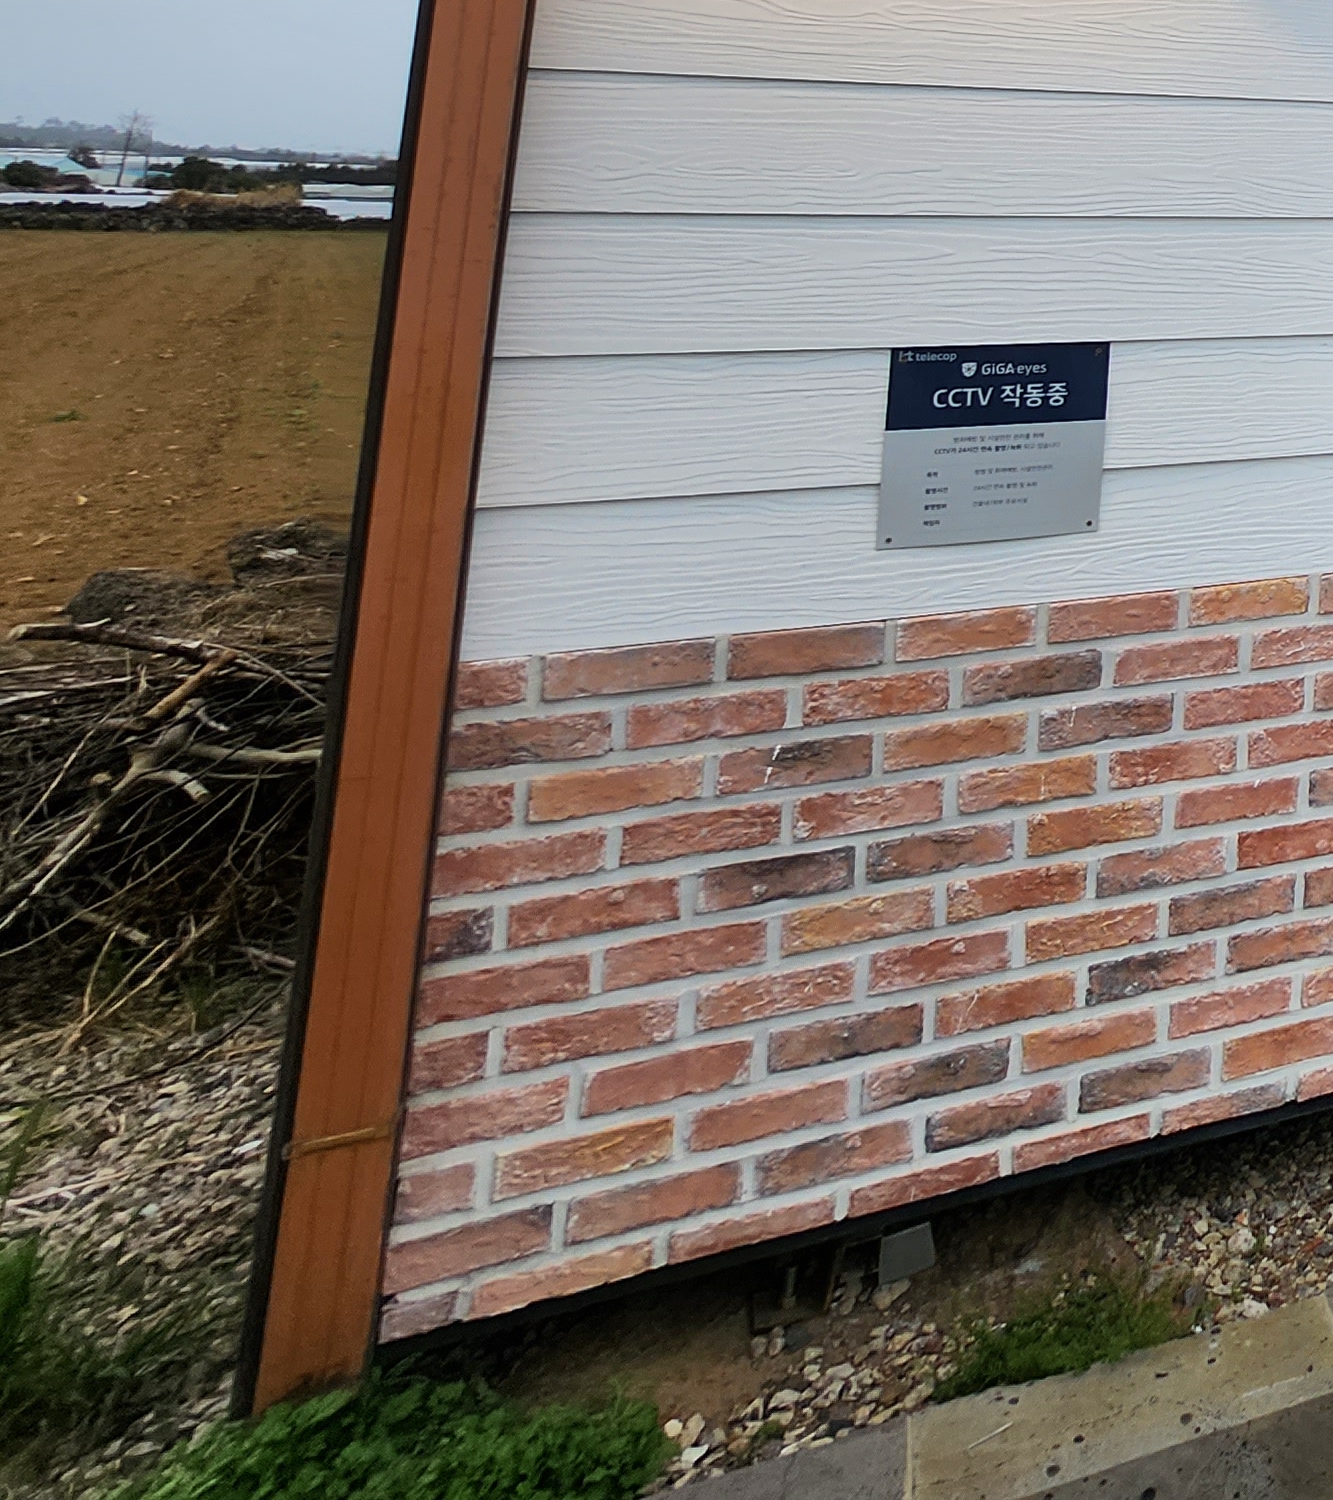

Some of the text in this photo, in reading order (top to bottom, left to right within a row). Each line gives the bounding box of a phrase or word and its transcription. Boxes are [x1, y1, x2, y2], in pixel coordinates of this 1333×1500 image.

[915, 351, 958, 363] telecop
[932, 382, 1069, 409] CCTV 작동중
